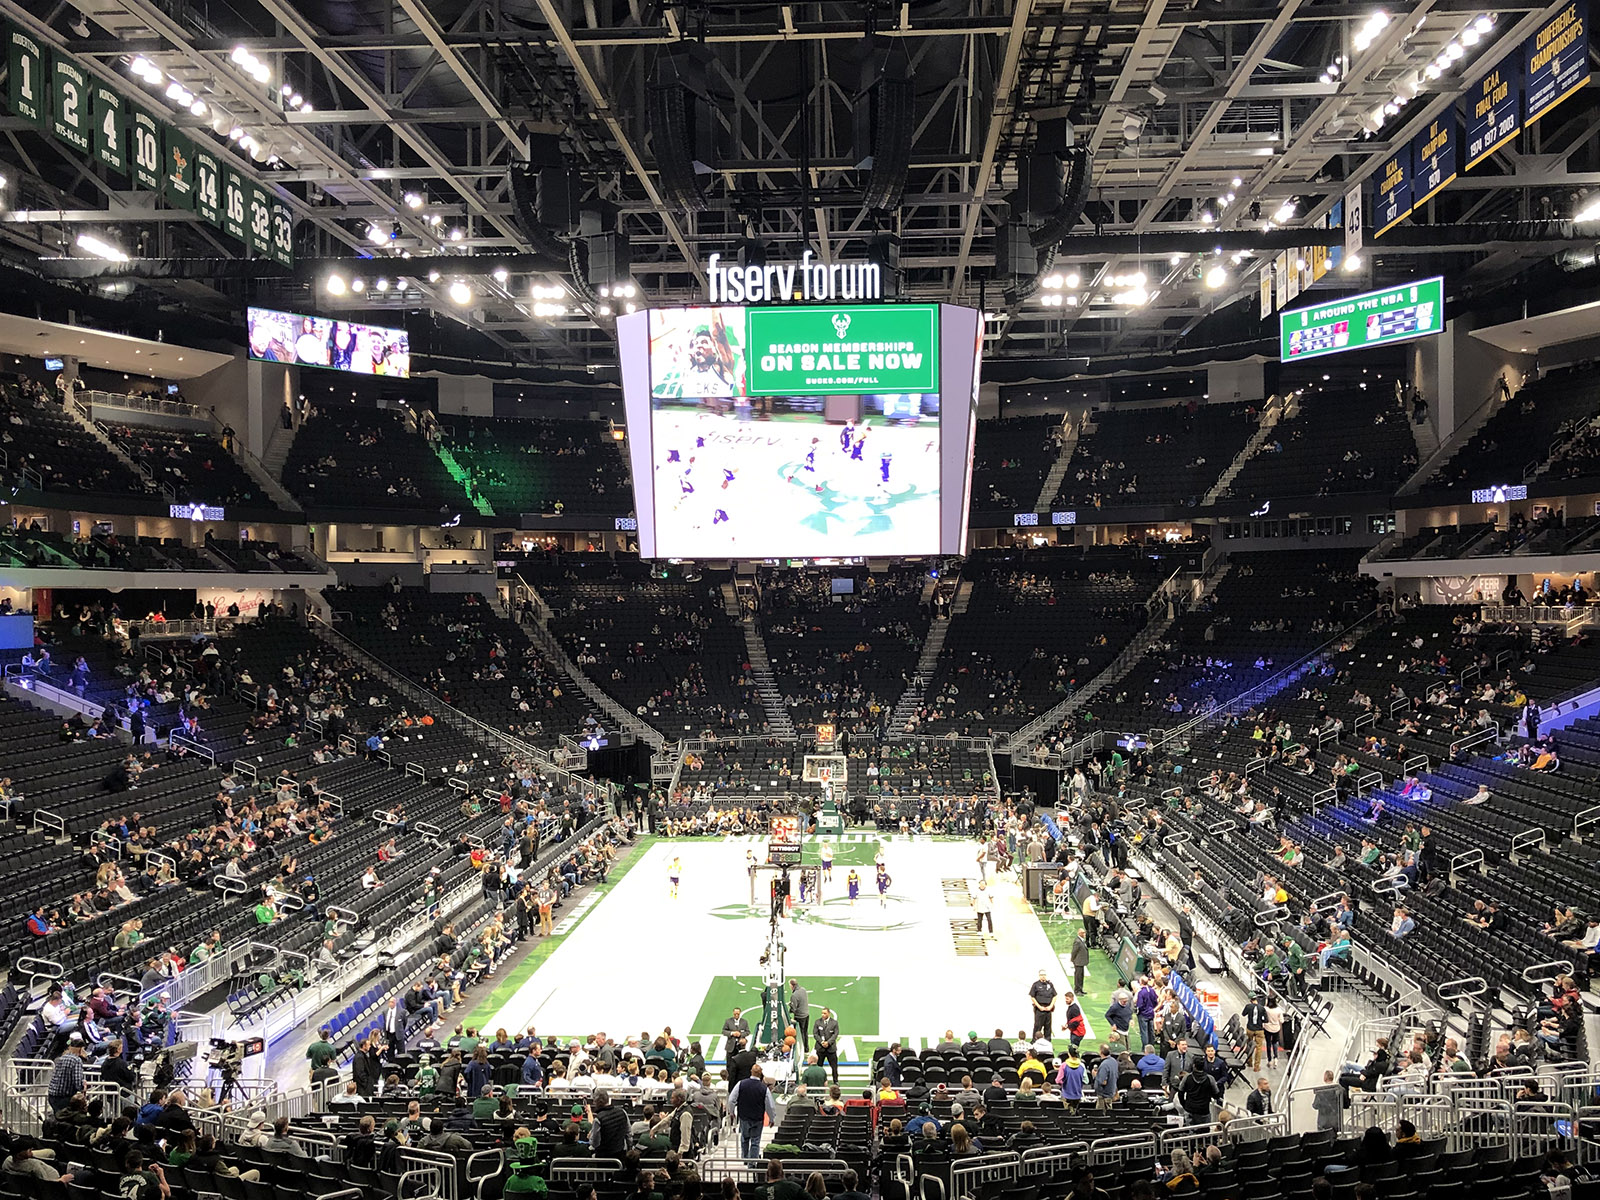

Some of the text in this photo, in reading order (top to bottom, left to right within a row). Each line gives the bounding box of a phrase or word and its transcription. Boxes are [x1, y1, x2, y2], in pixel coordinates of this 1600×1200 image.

[1537, 3, 1576, 50] CONFERENCE
[1531, 18, 1582, 74] CHAMPIONSHIPS
[21, 54, 32, 100] 1
[58, 62, 82, 86] BRIDGEMAN
[1483, 70, 1499, 96] NCAA
[63, 82, 78, 127] 2
[1476, 95, 1491, 119] FINAL
[1493, 81, 1508, 106] FOUR
[104, 109, 116, 150] 4
[1470, 114, 1514, 157] 1974 1977 2003
[136, 127, 156, 172] 10
[200, 167, 217, 209] 14
[1429, 169, 1440, 189] 1970
[227, 185, 244, 224] 16
[251, 201, 269, 240] 32
[1349, 207, 1359, 234] 43
[1386, 203, 1397, 222] 1977
[275, 216, 291, 252] 33
[800, 251, 880, 300] forum
[1313, 293, 1403, 321] AROUND THE NBA
[761, 353, 922, 371] ON SALE NOW
[769, 342, 914, 354] SEASON MEMBERSHIPS
[1014, 512, 1076, 526] FEAR DEER
[1480, 578, 1499, 590] FEAR
